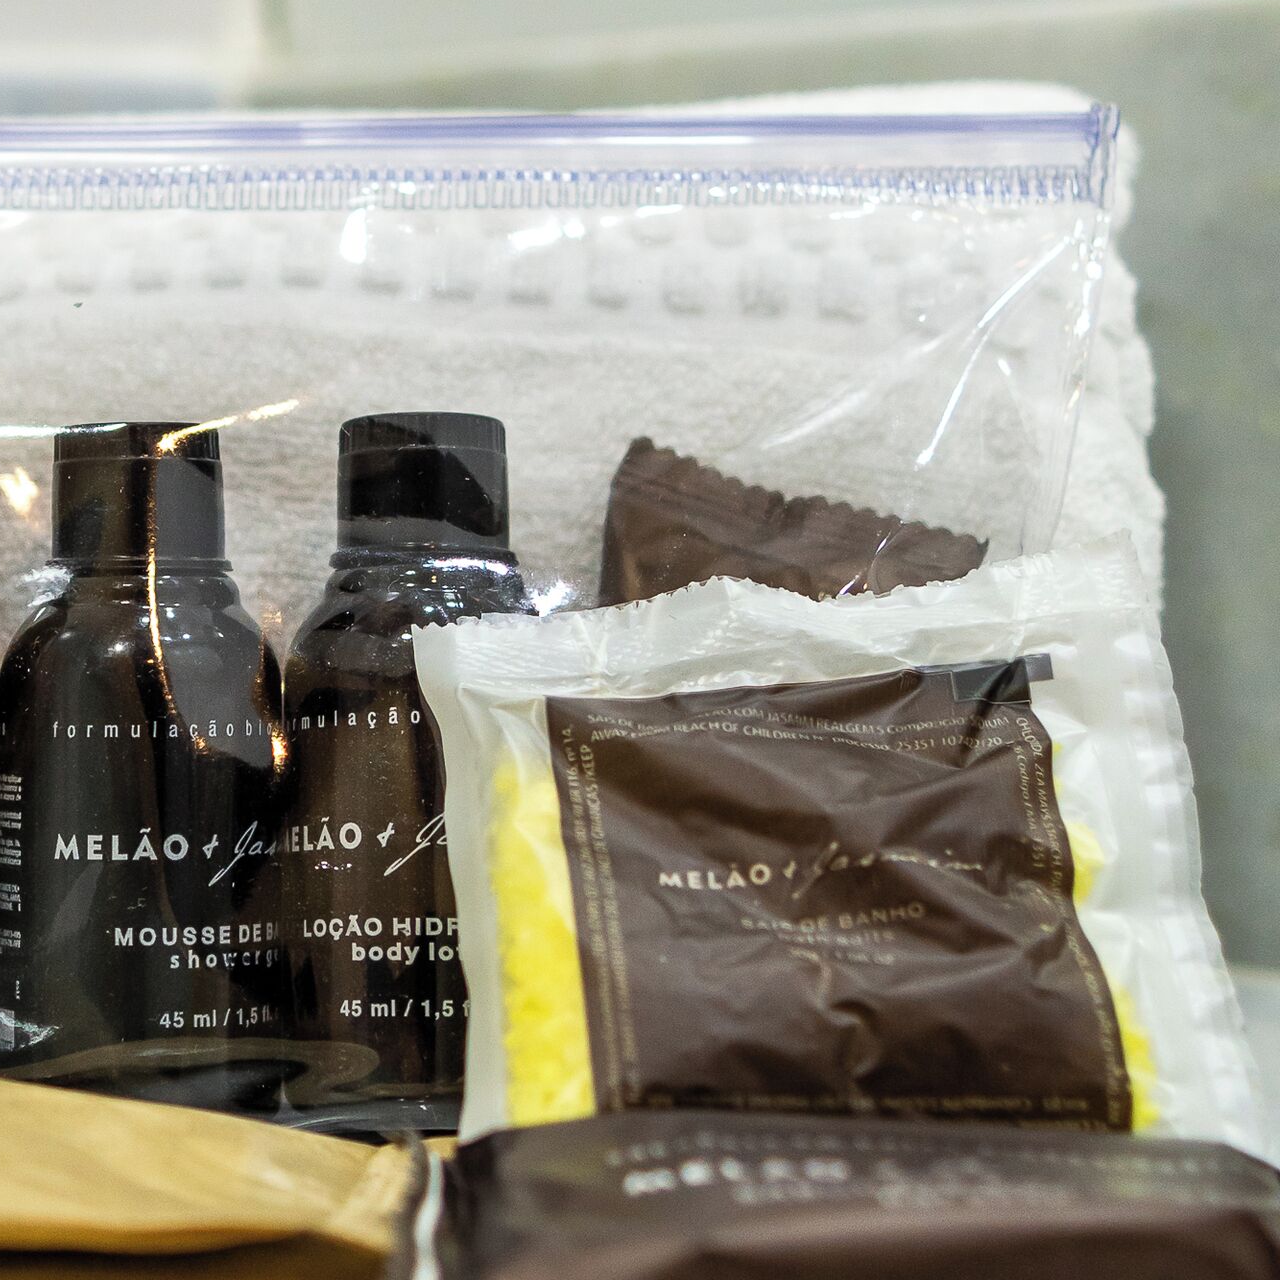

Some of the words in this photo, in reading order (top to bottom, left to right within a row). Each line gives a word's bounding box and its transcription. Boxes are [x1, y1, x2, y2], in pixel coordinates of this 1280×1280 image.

[53, 719, 234, 741] formulação
[54, 828, 189, 861] MELÃO
[114, 925, 231, 946] MOUSSE
[238, 923, 262, 943] DE
[303, 914, 383, 941] LOÇÃO
[351, 942, 420, 966] body
[159, 1012, 184, 1029] 45
[193, 1009, 217, 1028] ml
[236, 1007, 258, 1028] 1,5
[339, 999, 362, 1018] 45
[371, 1000, 396, 1018] ml
[403, 999, 413, 1018] /
[421, 999, 454, 1021] 1,5
